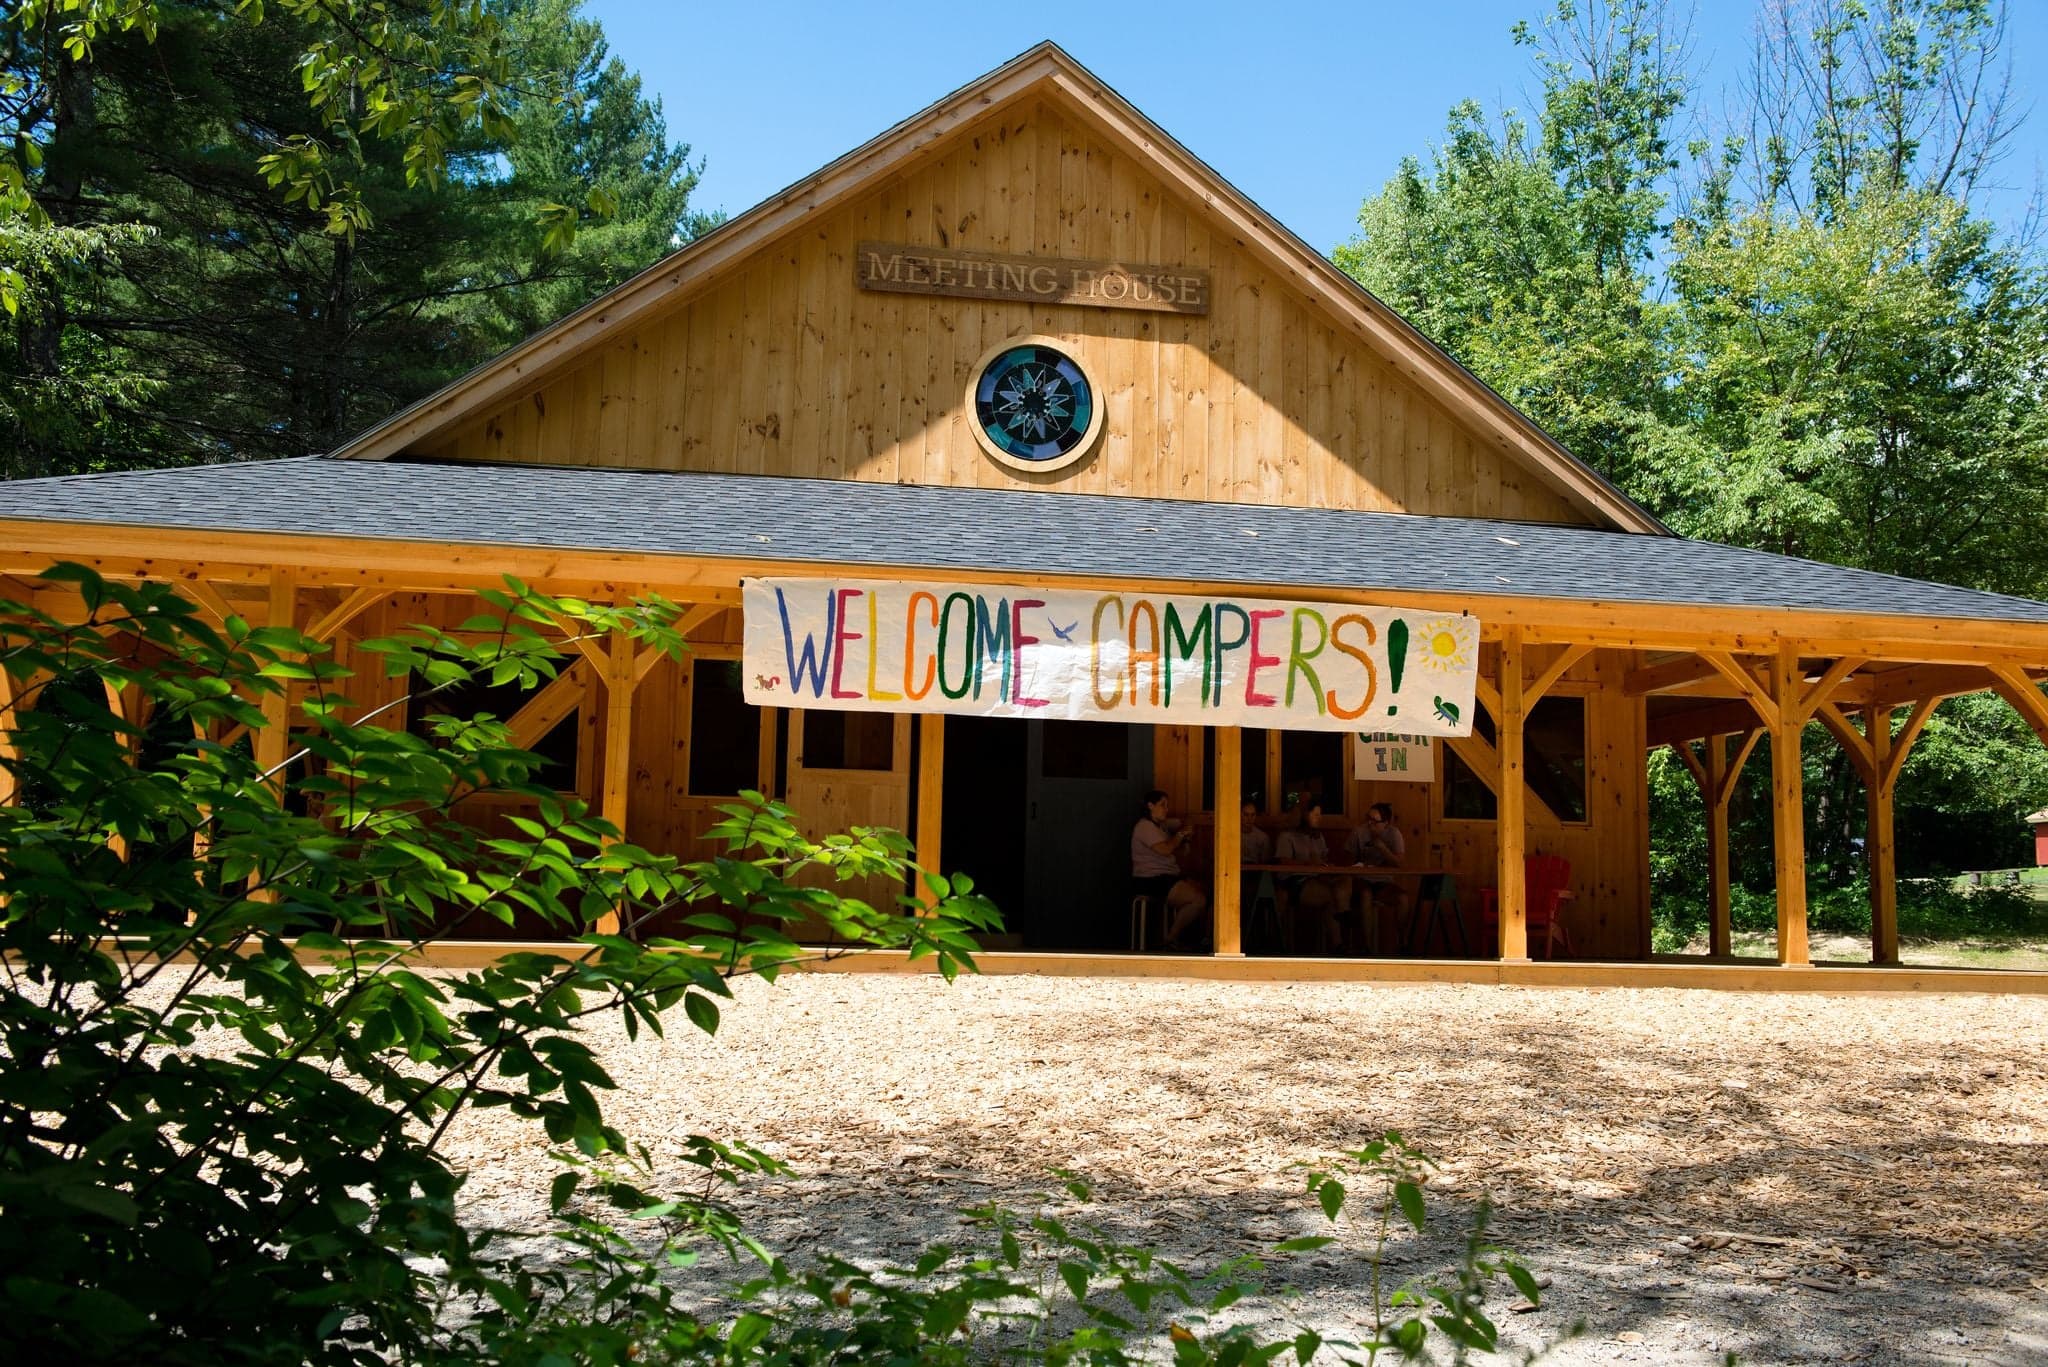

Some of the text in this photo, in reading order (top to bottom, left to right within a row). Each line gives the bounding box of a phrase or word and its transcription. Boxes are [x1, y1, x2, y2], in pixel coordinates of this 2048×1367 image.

[867, 252, 1201, 305] MEETING HOUSE
[775, 586, 1409, 720] WELCOME CAMPERS!
[1374, 747, 1408, 772] IN
